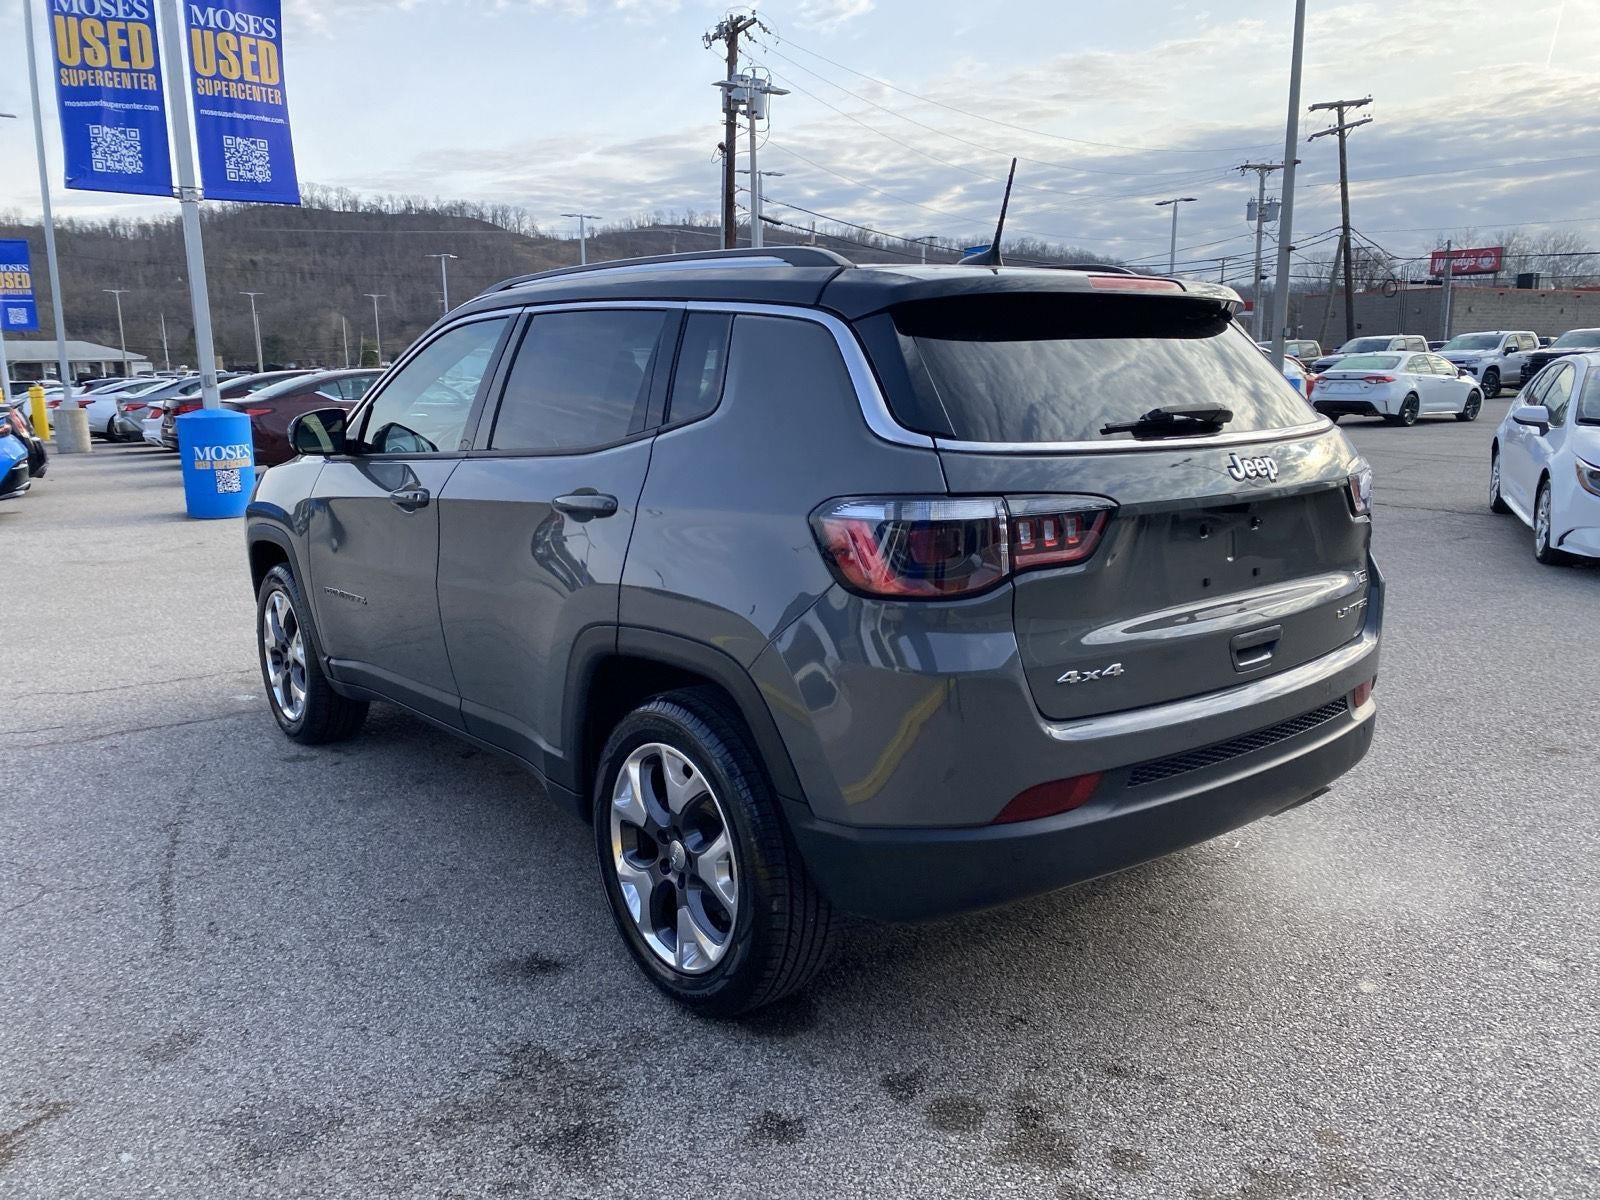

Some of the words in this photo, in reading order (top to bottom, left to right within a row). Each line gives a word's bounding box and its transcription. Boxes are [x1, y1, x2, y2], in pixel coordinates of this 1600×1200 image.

[54, 0, 150, 19] MOSES
[190, 4, 277, 38] MOSES
[54, 15, 155, 70] USED
[191, 28, 280, 86] USED
[60, 69, 158, 91] SUPERCENTER
[196, 78, 283, 105] SUPERCENTER
[64, 99, 160, 112] mosesusedsupercenter.com
[199, 108, 286, 125] mosesusedsupercenter.com
[193, 443, 251, 461] MOSES
[1228, 452, 1279, 484] Jeep
[1056, 662, 1125, 684] 4x4
